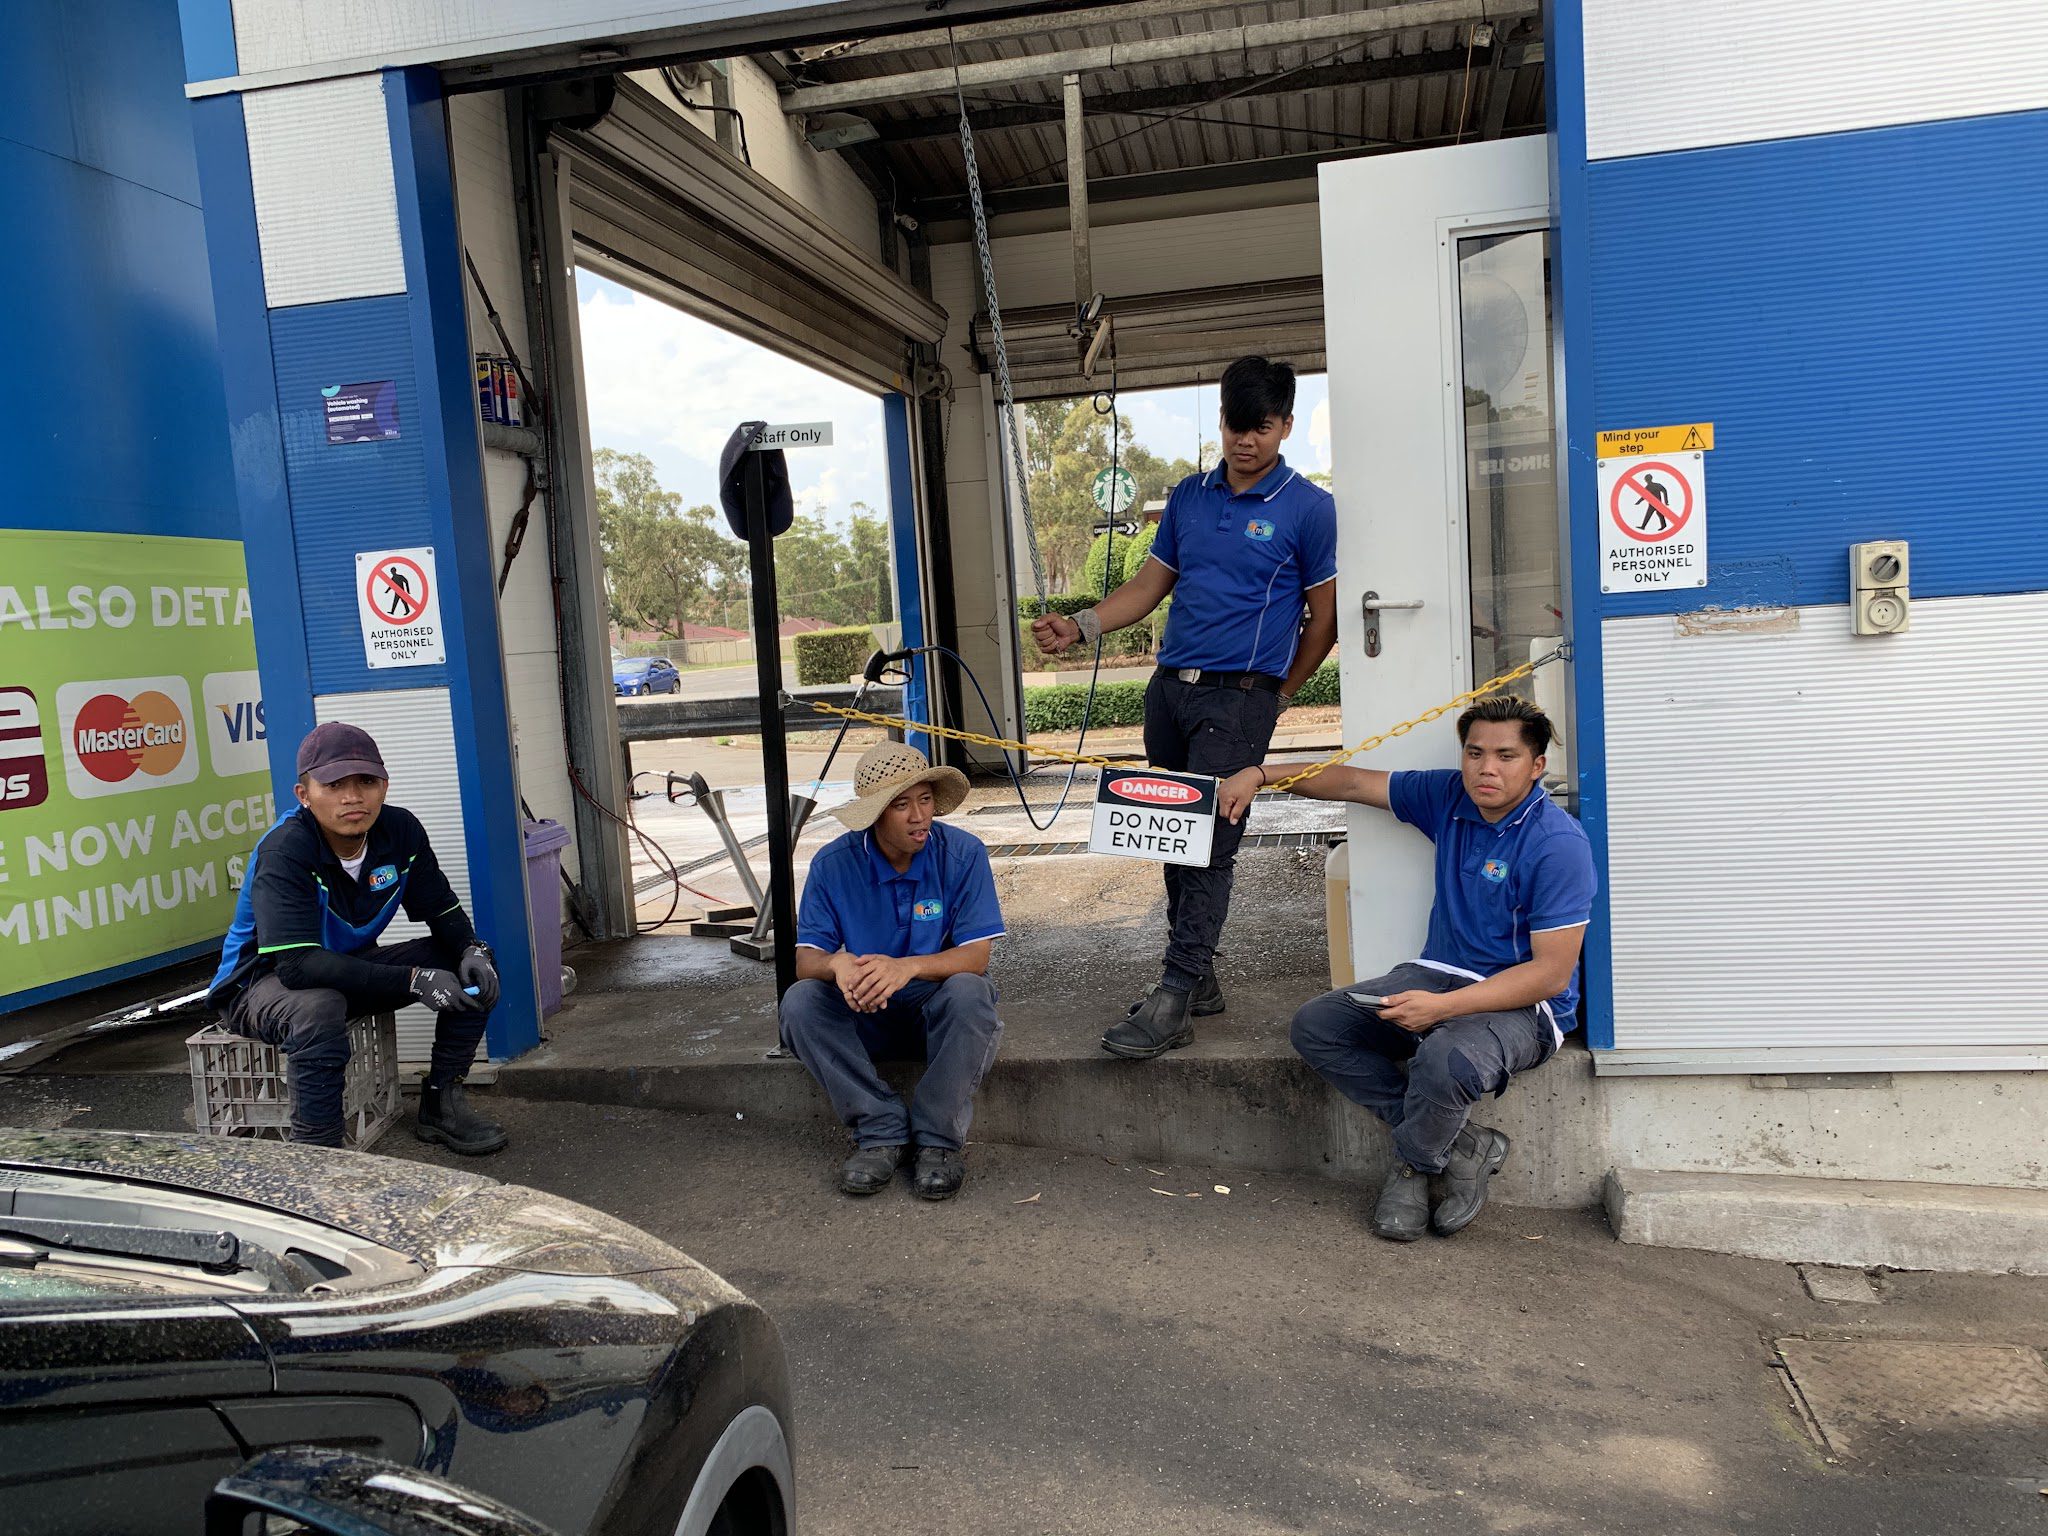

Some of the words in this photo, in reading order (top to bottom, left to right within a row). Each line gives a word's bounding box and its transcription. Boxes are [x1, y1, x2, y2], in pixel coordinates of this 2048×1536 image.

[346, 397, 368, 405] washing
[754, 430, 786, 444] Staff
[790, 429, 821, 443] Only
[1603, 432, 1631, 442] Mind
[1634, 430, 1660, 443] your
[1619, 444, 1644, 454] step
[1609, 544, 1694, 559] AUTHORISED
[1612, 558, 1692, 571] PERSONNEL
[1634, 572, 1670, 583] ONLY
[0, 586, 136, 631] ALSO
[371, 627, 433, 639] AUTHORISED
[374, 638, 434, 650] PERSONNEL
[391, 650, 417, 660] ONLY
[78, 720, 183, 755] MasterCard
[1121, 781, 1189, 799] DANGER
[1109, 811, 1141, 828] DO
[1149, 815, 1197, 834] NOT
[25, 815, 156, 877] NOW
[1112, 831, 1188, 855] ENTER
